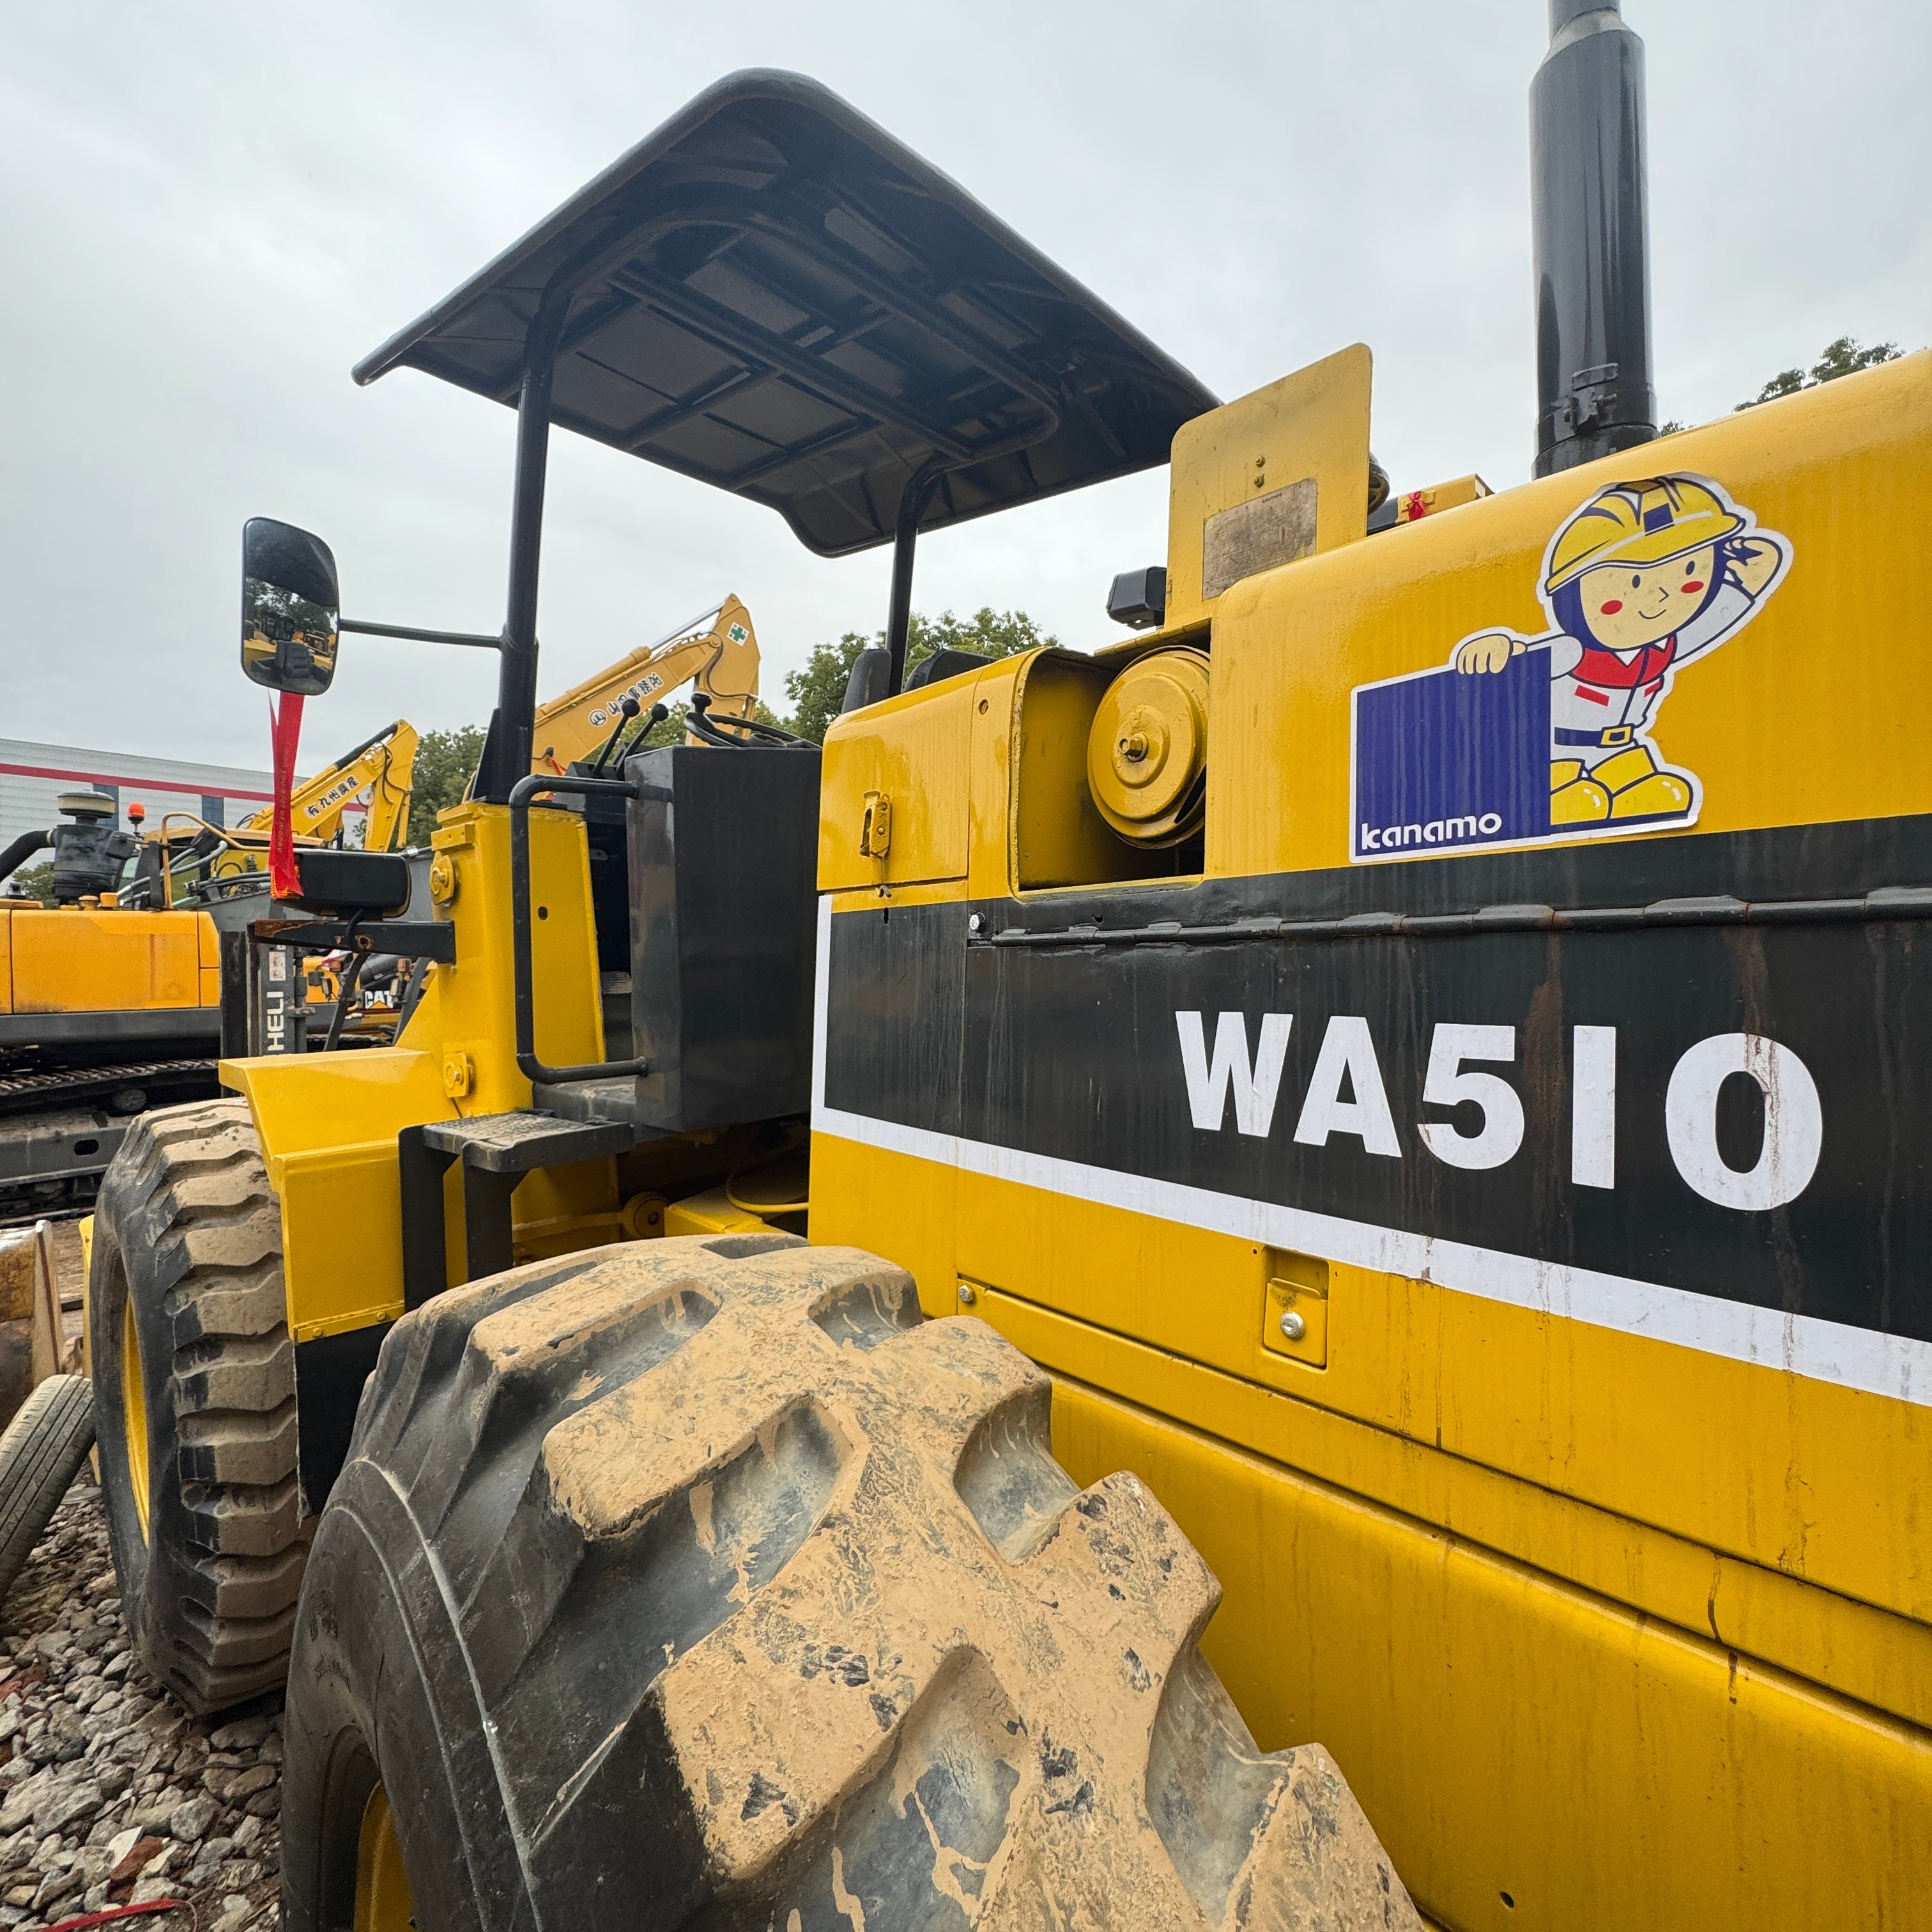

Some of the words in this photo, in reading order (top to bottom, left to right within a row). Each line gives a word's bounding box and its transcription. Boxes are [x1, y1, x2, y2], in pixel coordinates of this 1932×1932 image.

[1361, 813, 1502, 850] kanamo
[266, 992, 284, 1051] HELI
[365, 990, 394, 1009] CAT
[1176, 1011, 1823, 1212] WA510
